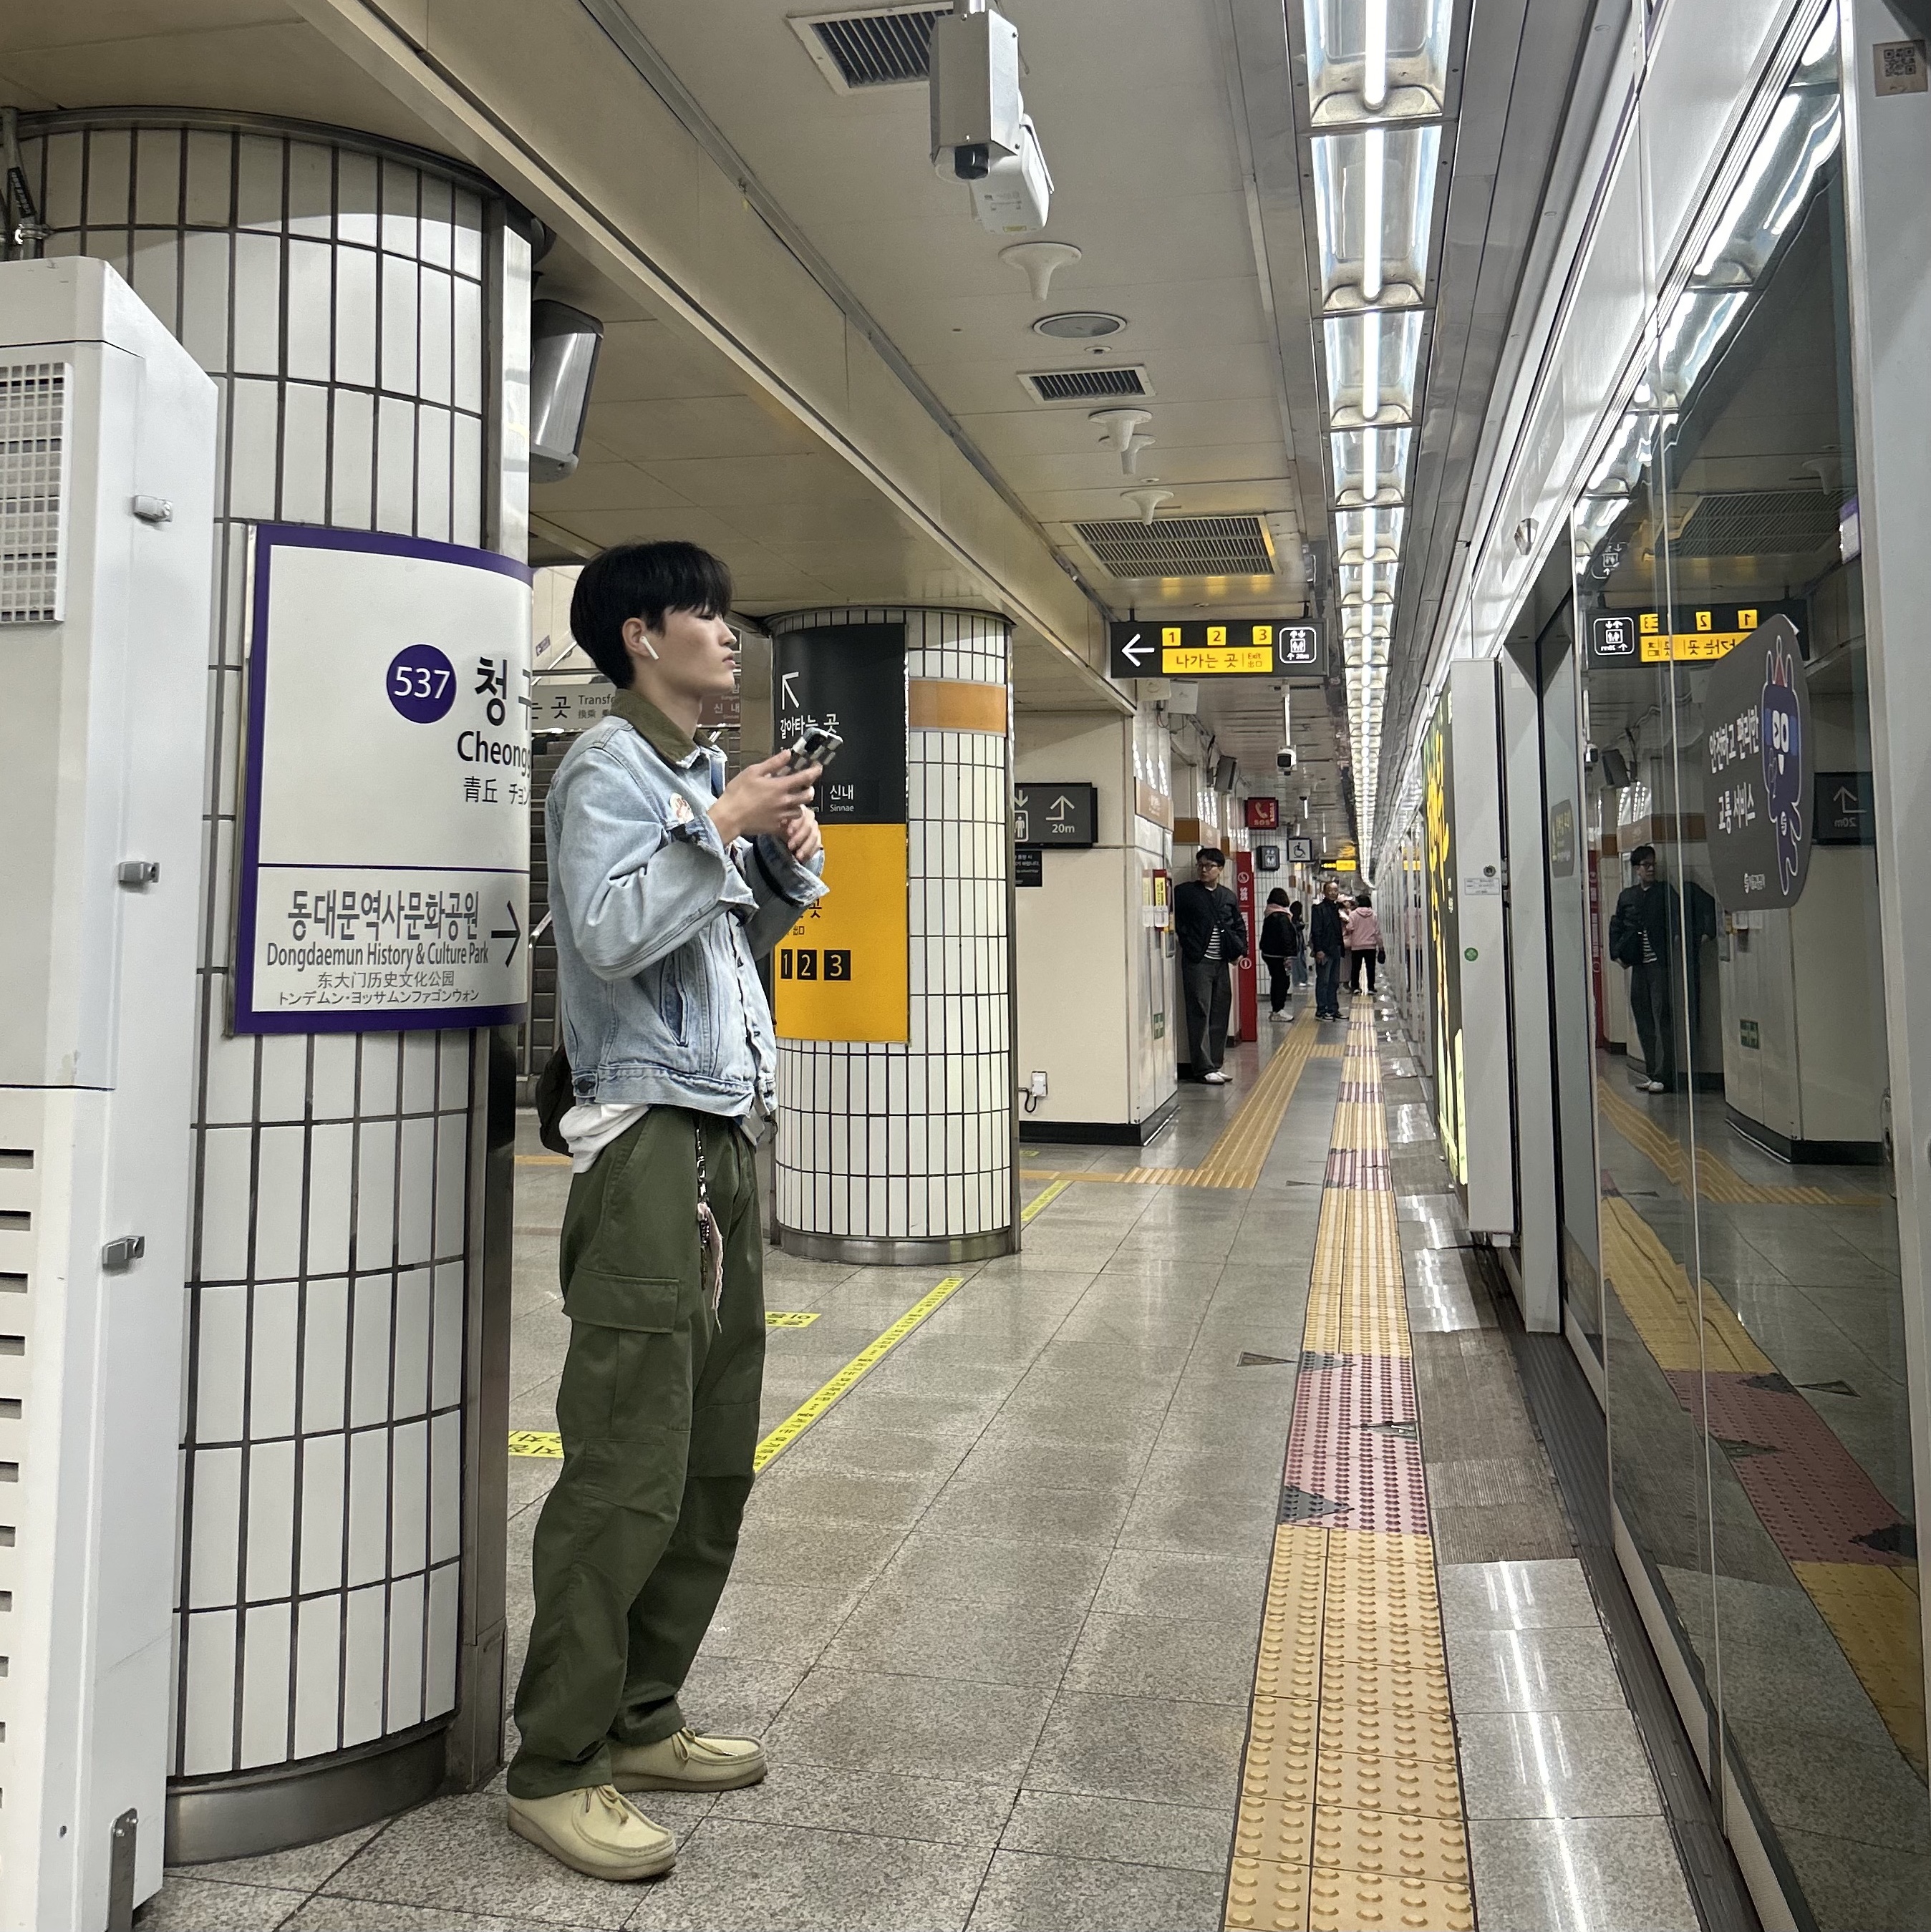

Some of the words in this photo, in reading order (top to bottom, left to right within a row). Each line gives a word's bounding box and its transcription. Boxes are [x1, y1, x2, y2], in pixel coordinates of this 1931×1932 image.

[1169, 632, 1175, 643] 1
[1213, 631, 1221, 642] 2
[1259, 629, 1267, 641] 3
[1176, 654, 1219, 669] 나가는
[1224, 653, 1238, 668] 곳
[394, 666, 450, 699] 537
[551, 696, 571, 719] 곳
[780, 714, 819, 739] 갈아타는
[823, 713, 840, 733] 곳
[1709, 723, 1736, 774] 안전하고
[1736, 704, 1759, 760] 편리한
[829, 784, 854, 800] 신내
[829, 803, 855, 812] Sinnae
[1718, 790, 1733, 835] 교통
[1733, 782, 1756, 829] 서비스
[1052, 824, 1075, 833] 20m
[288, 889, 479, 941] 동대문역사문화공원
[266, 941, 364, 972] Dongdaemun
[367, 941, 417, 971] History
[416, 943, 425, 964] &
[427, 941, 467, 964] Culture
[469, 941, 489, 964] Park
[800, 953, 811, 976] 2
[830, 953, 843, 977] 3
[317, 970, 455, 989] 东大门历史文化公园
